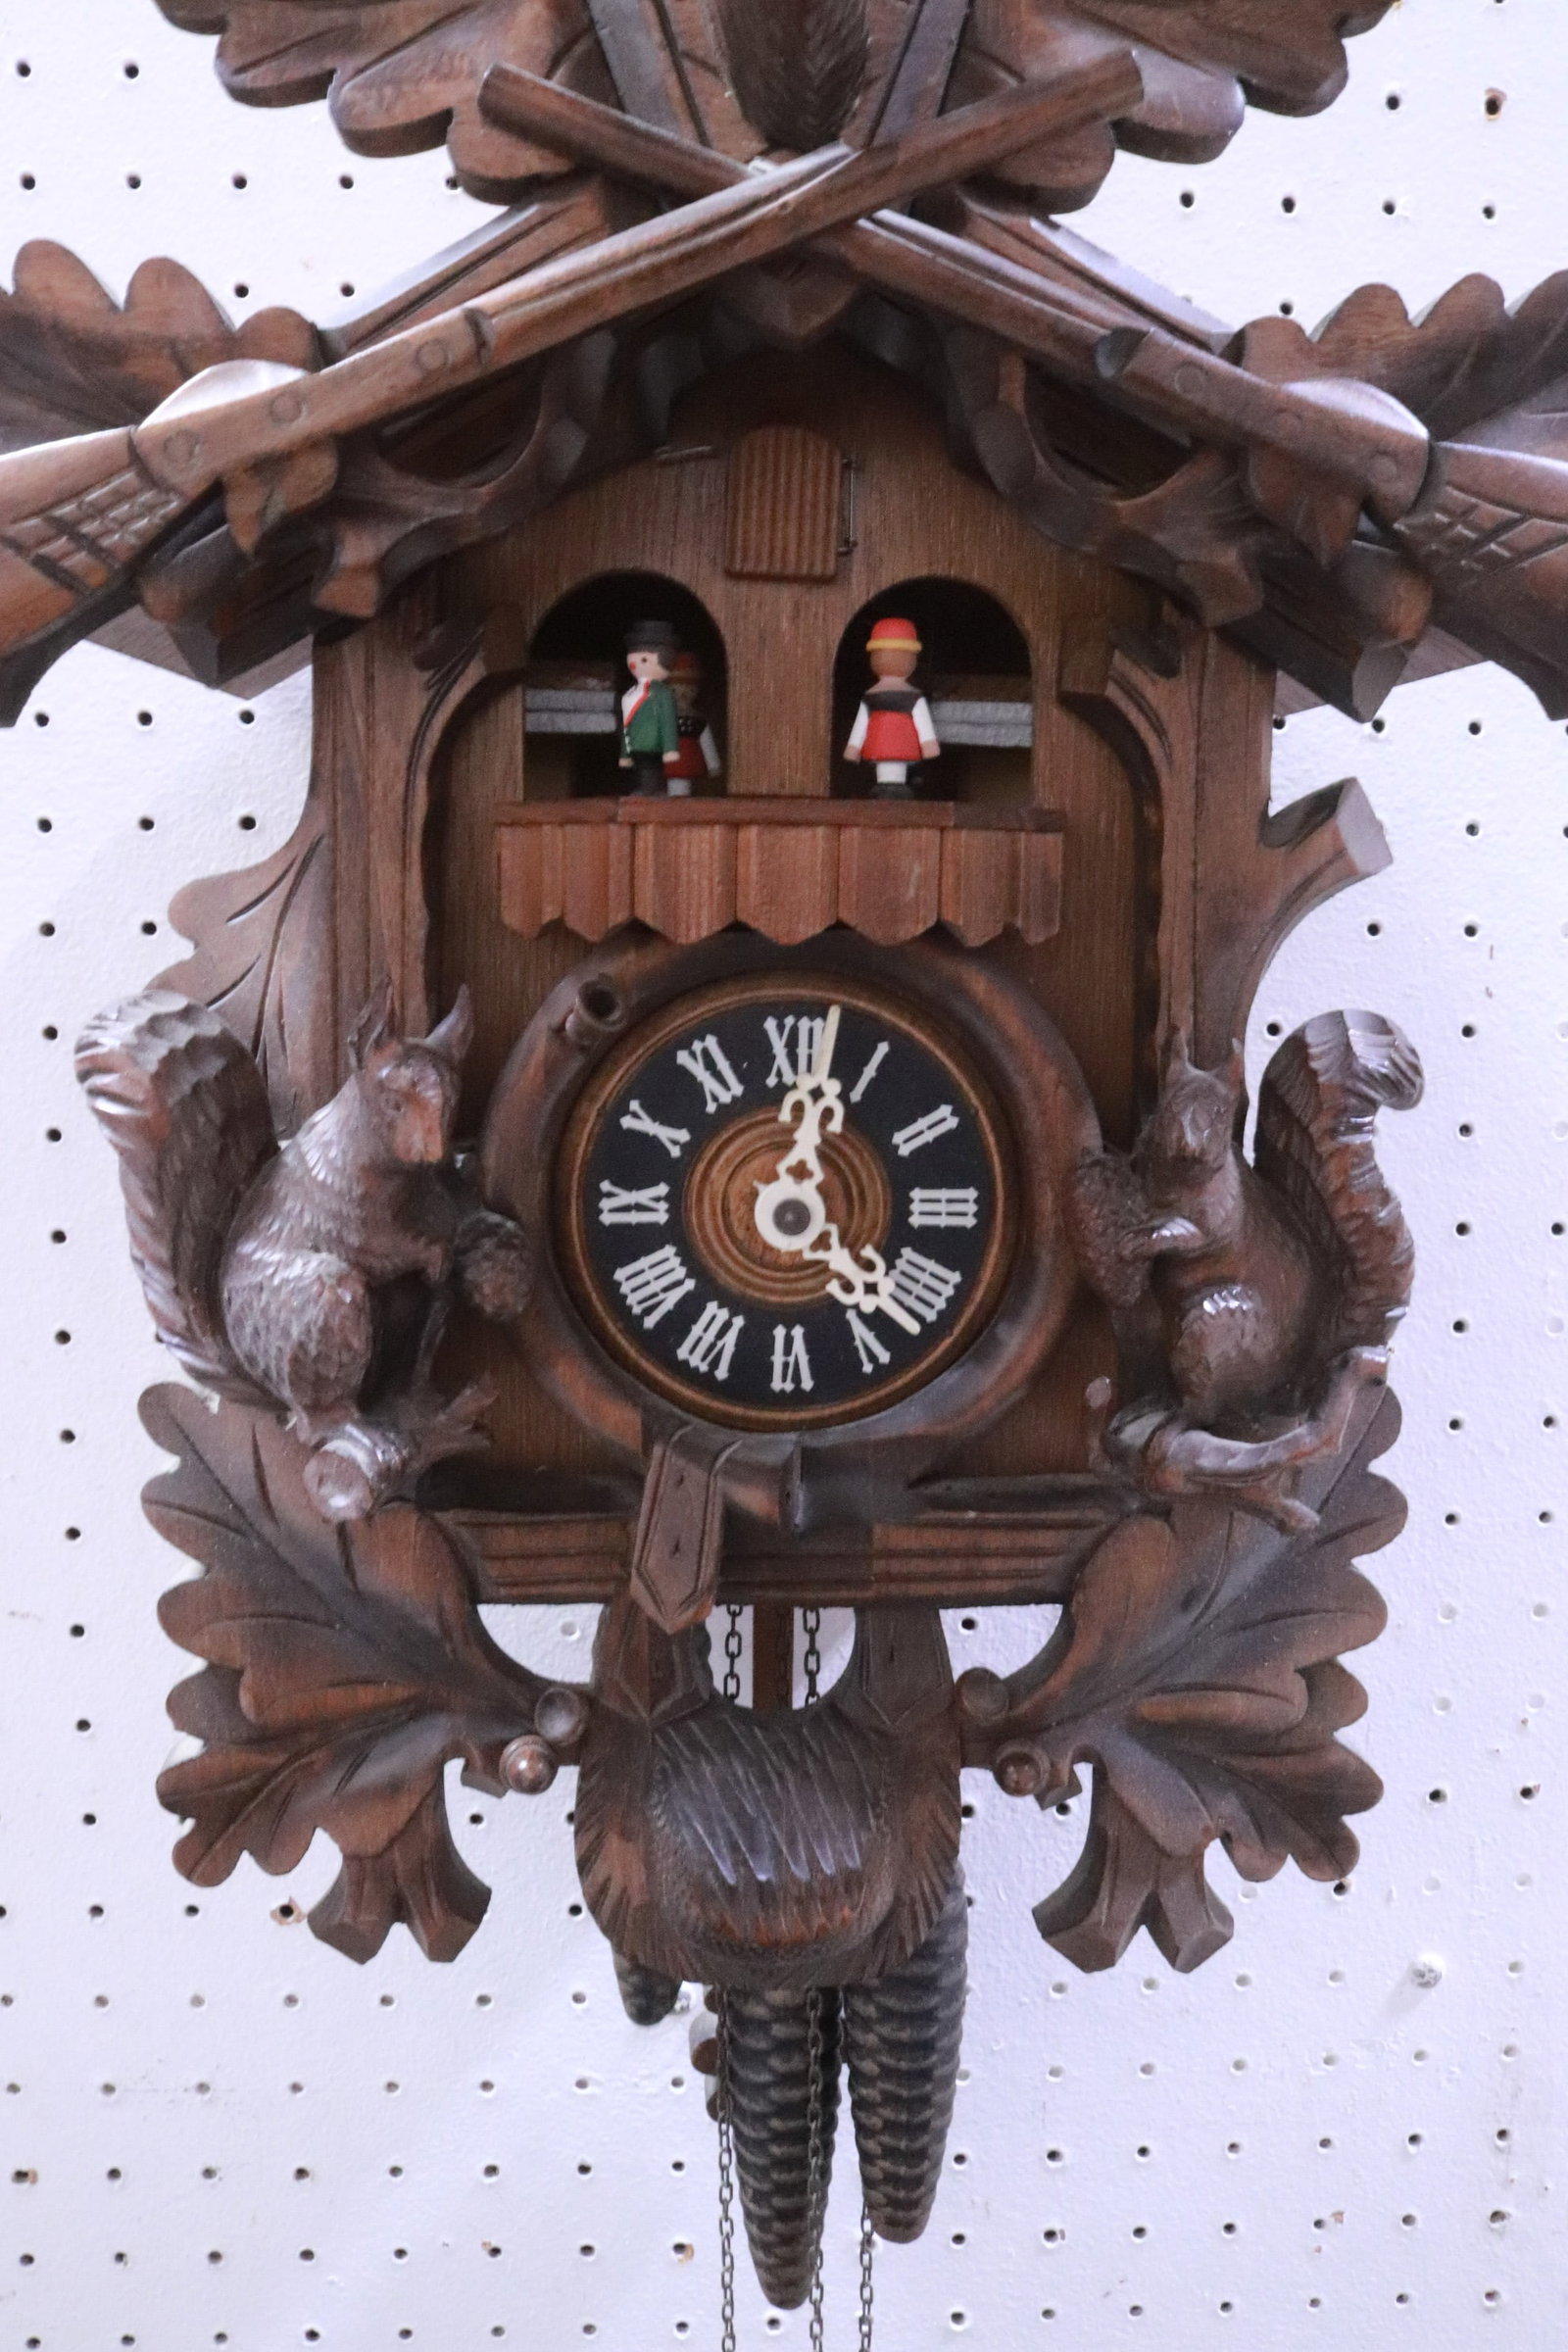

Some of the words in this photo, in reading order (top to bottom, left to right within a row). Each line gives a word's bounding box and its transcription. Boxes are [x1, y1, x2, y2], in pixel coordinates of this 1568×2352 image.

[676, 1034, 745, 1114] XI
[763, 1015, 826, 1088] XII
[850, 1041, 890, 1103] I
[619, 1100, 692, 1158] X
[892, 1103, 959, 1156] II
[599, 1179, 670, 1226] IX
[908, 1187, 979, 1228] III
[613, 1244, 697, 1330] VIII
[888, 1247, 962, 1323] IIII
[676, 1300, 745, 1382] VII
[770, 1324, 814, 1393] VI
[846, 1308, 891, 1374] V
